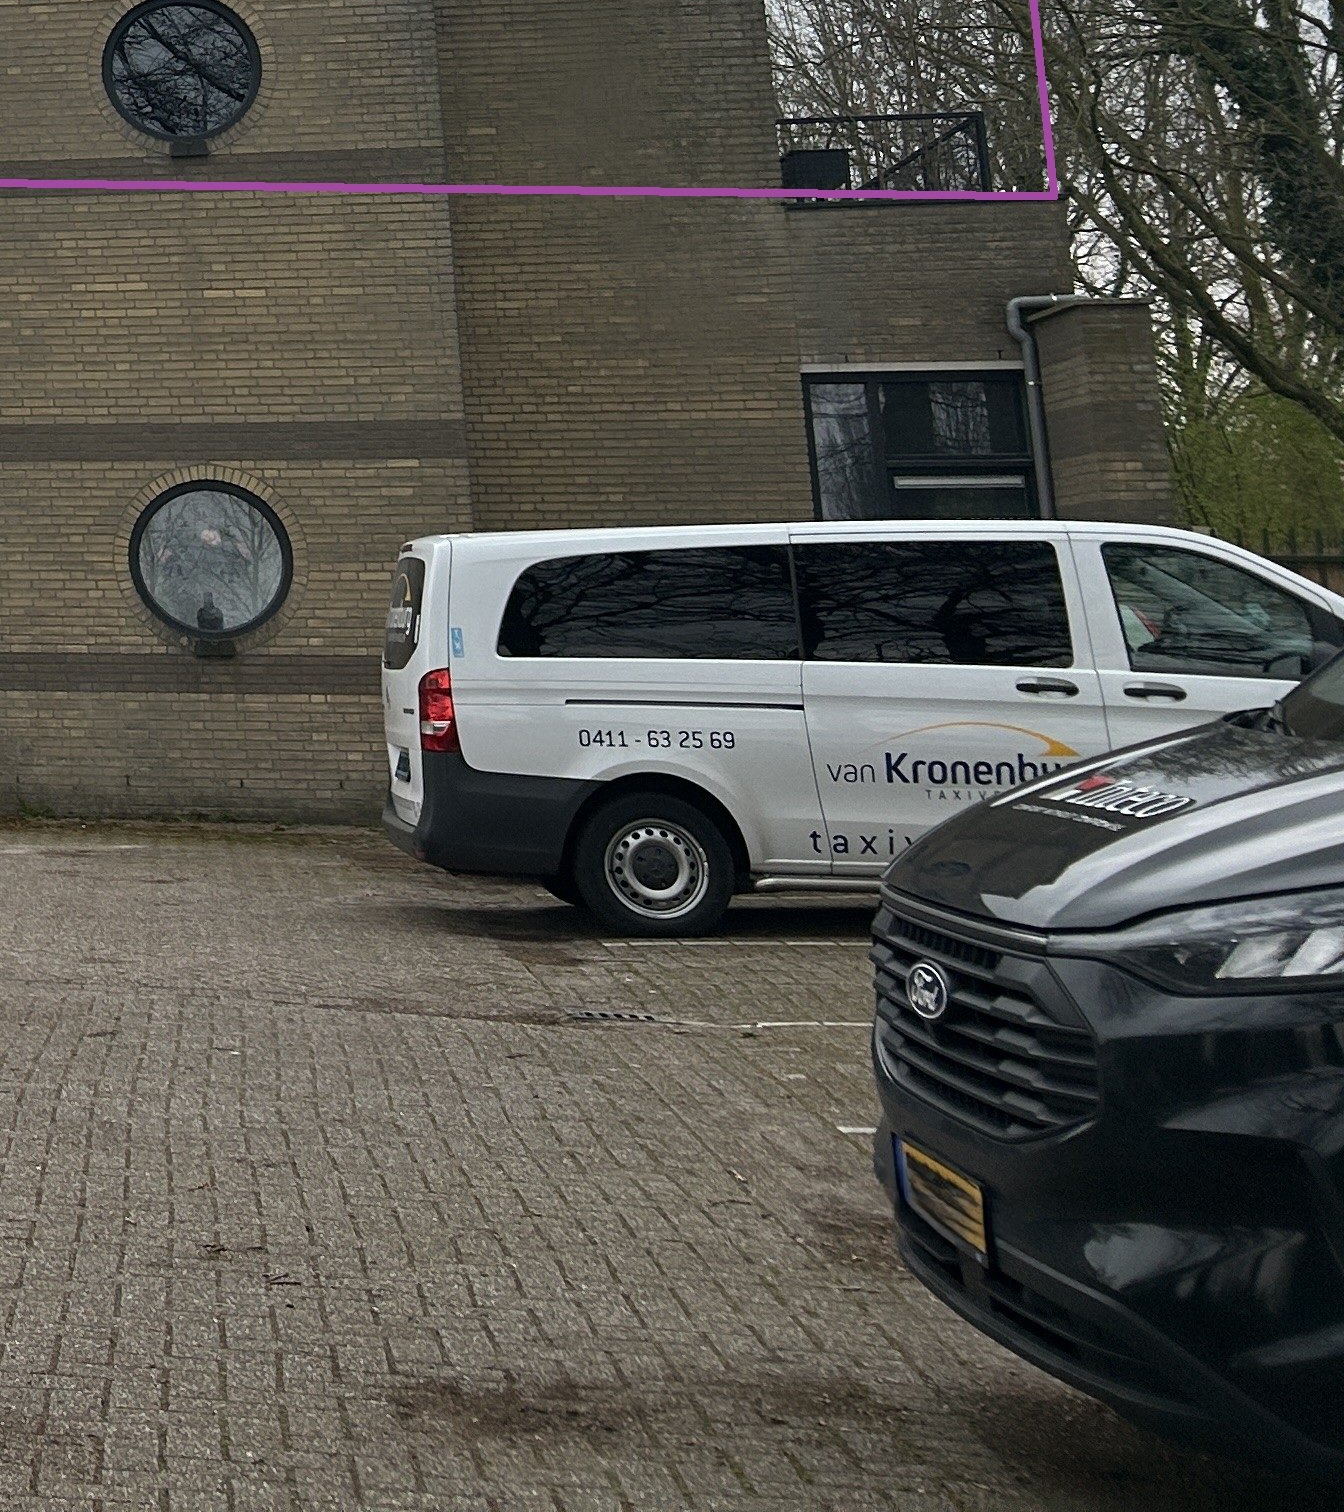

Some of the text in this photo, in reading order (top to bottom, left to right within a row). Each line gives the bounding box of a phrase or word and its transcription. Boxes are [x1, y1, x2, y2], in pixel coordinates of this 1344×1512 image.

[578, 729, 628, 748] 0411
[647, 730, 671, 748] 63
[678, 730, 703, 749] 25
[710, 731, 735, 749] 69
[826, 763, 875, 783] van
